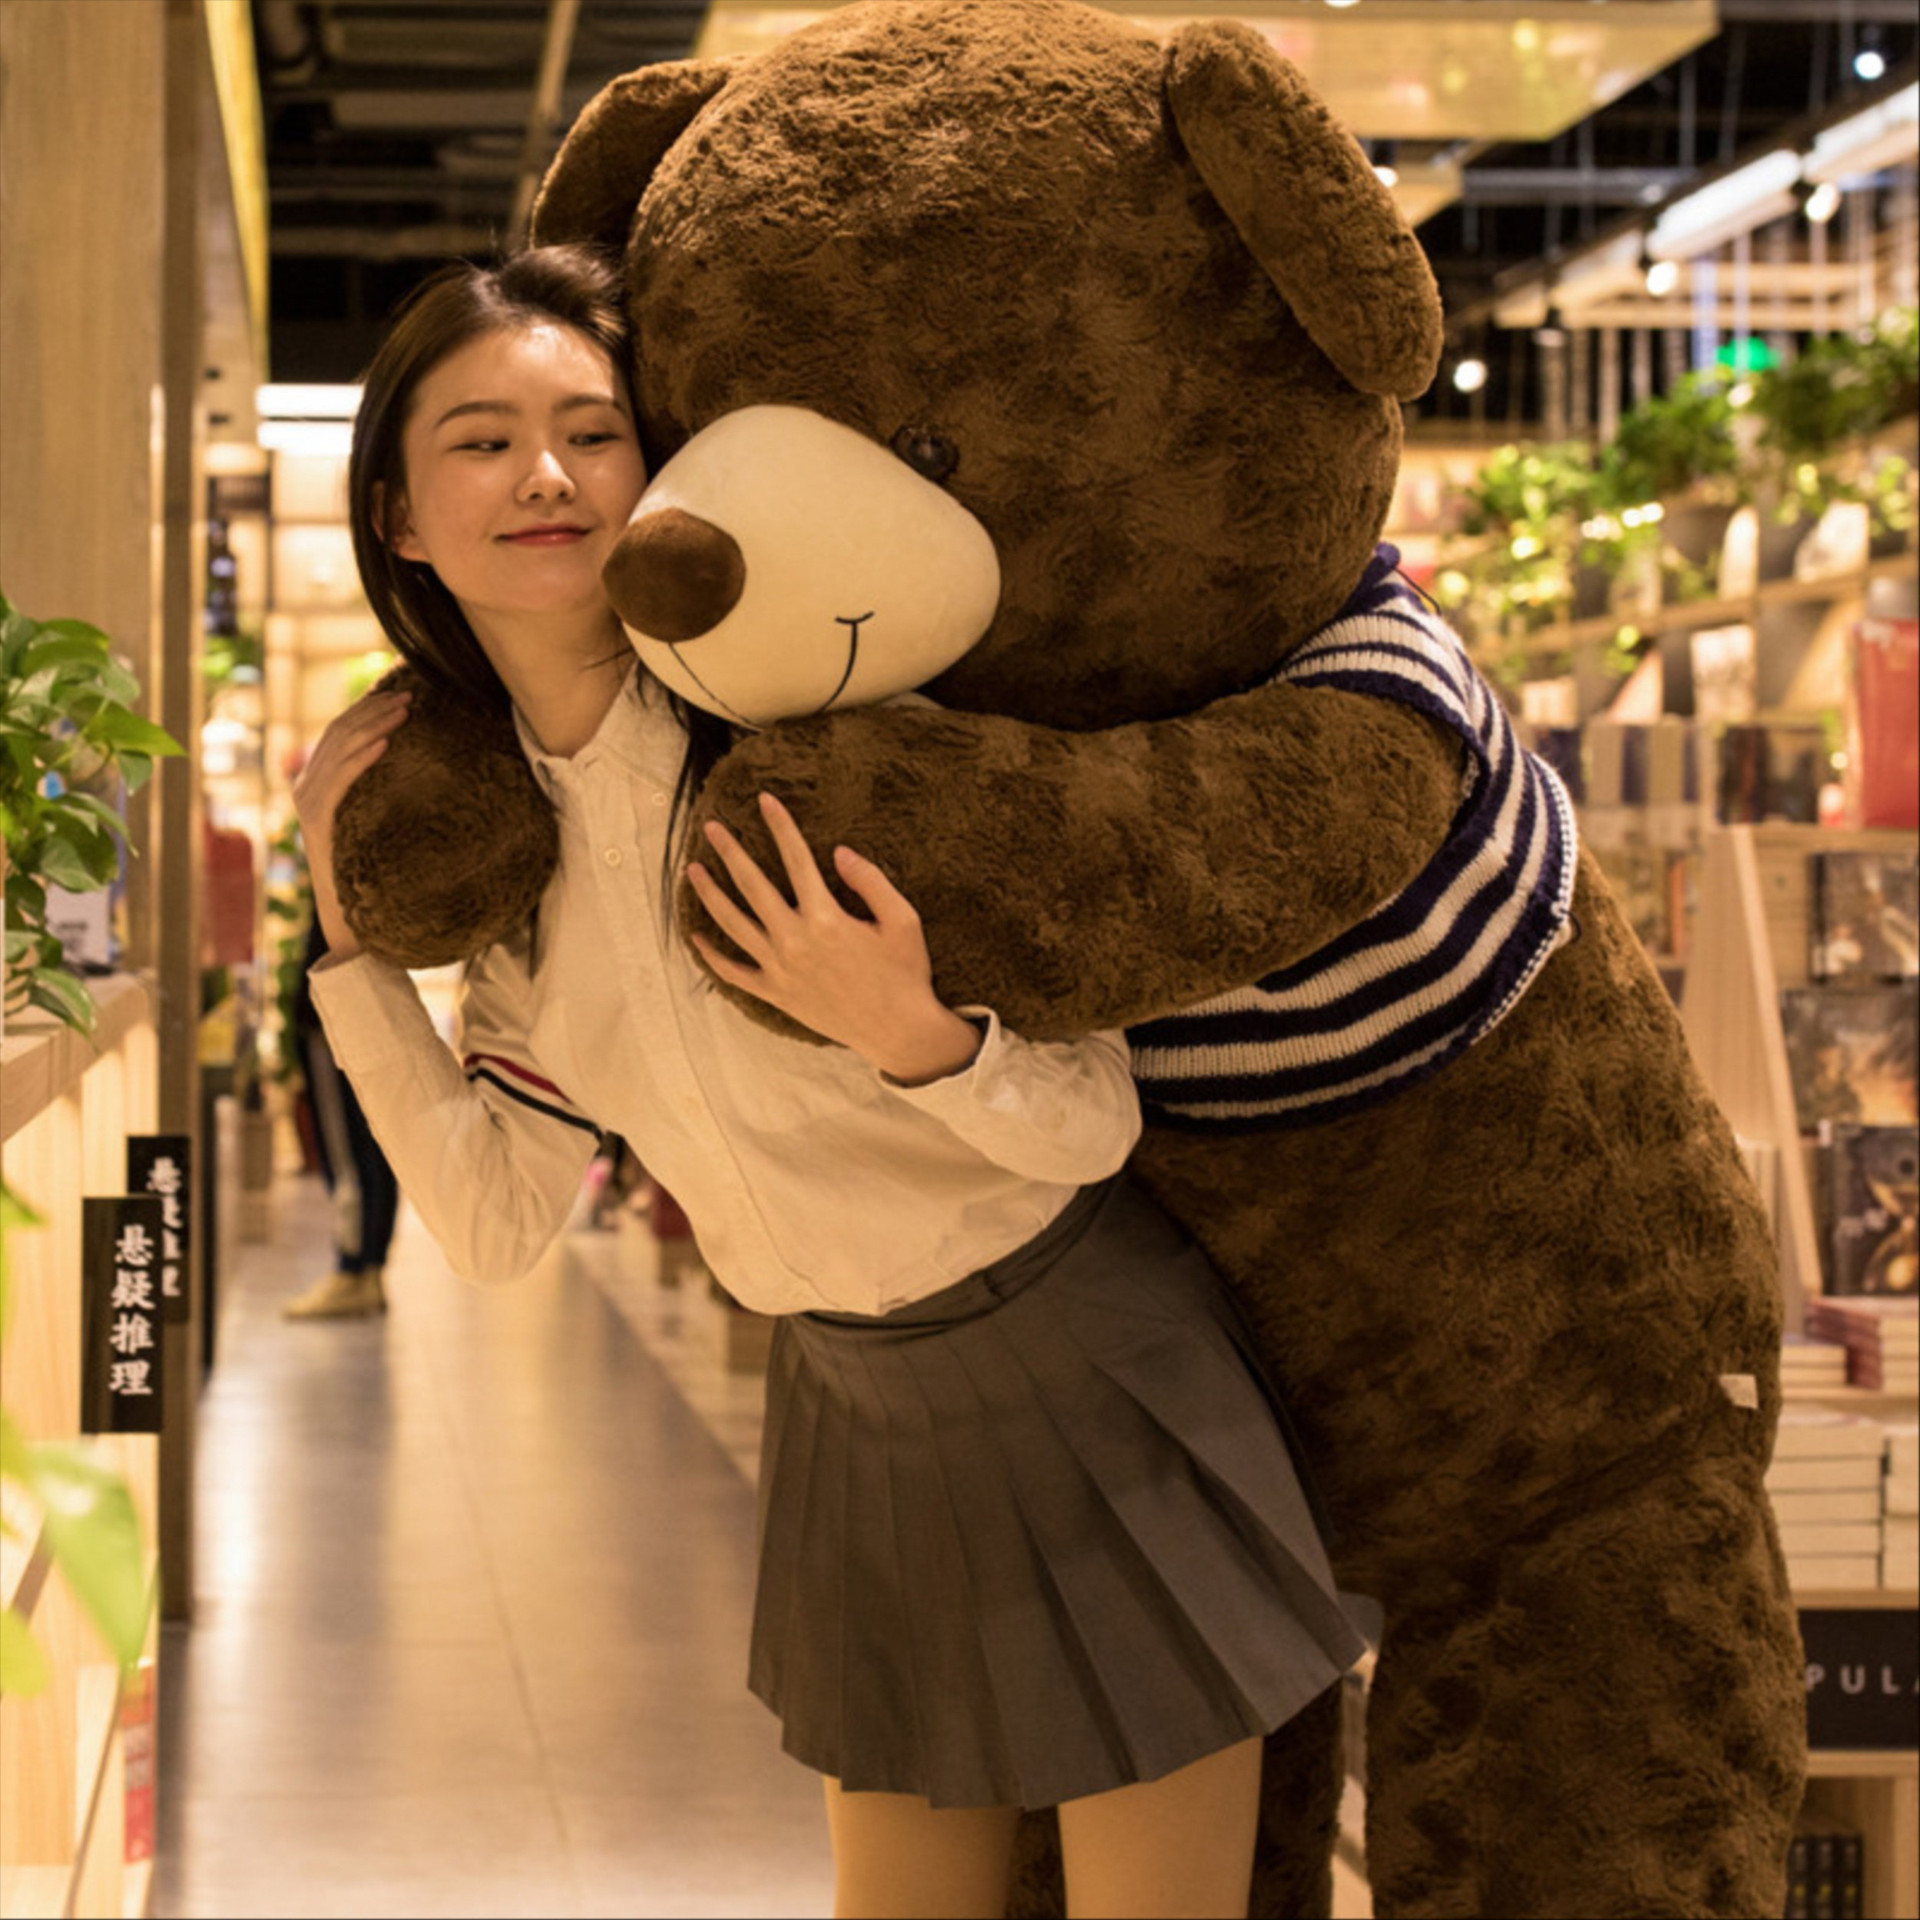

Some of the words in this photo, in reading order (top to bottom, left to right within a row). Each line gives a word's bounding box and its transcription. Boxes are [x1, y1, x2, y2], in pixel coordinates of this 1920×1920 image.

[108, 1224, 155, 1395] 悬疑推理
[1805, 1663, 1919, 1694] PUL
